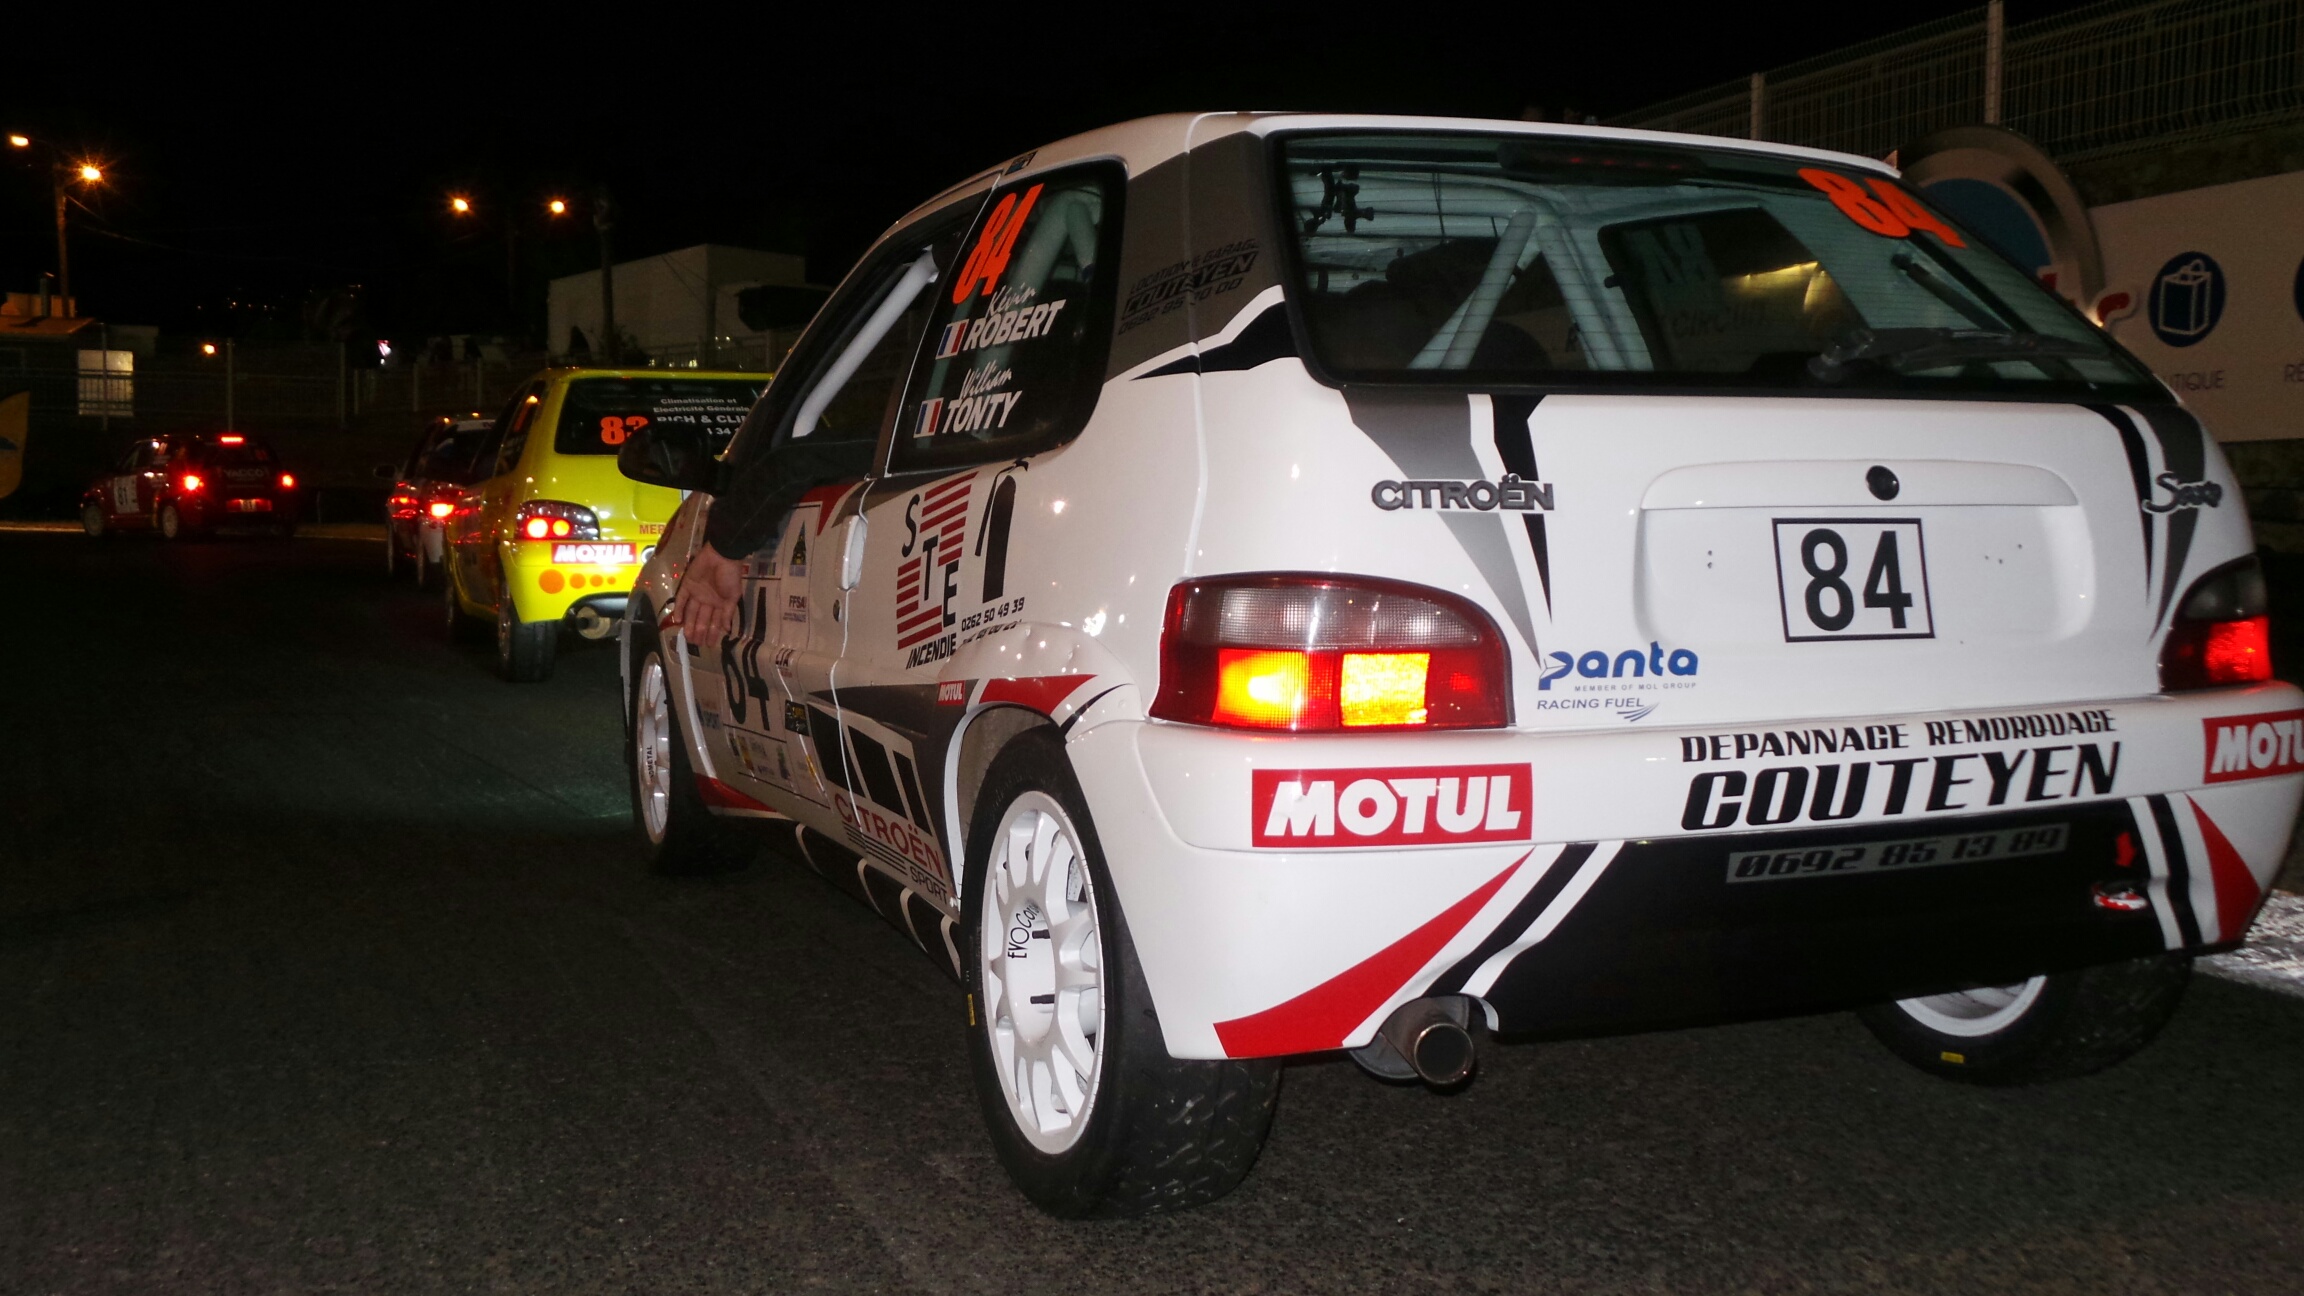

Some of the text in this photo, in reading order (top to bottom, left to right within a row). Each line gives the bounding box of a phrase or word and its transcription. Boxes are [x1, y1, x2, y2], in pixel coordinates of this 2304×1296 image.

[1799, 168, 1967, 248] 84
[952, 182, 1044, 305] 84
[963, 299, 1067, 352] ROBERT
[701, 414, 713, 424] &
[941, 390, 1023, 434] TONTY
[1371, 472, 1555, 511] CITROËN
[554, 543, 635, 564] MOTUL
[1799, 527, 1912, 632] 84
[961, 596, 1025, 632] 0262 50 49 39
[905, 632, 957, 671] INCENDIE
[938, 682, 963, 703] MOTUL
[1537, 696, 1645, 710] RACING FUEL
[1574, 684, 1618, 692] MEMBER
[1663, 682, 1698, 690] GROUP
[1681, 708, 2118, 763] DEPANNAGE REMORQUAGE
[1263, 775, 1522, 837] MOTUL
[1681, 741, 2123, 832] COUTEYEN
[834, 793, 944, 880] CITROËN
[1734, 825, 2062, 878] 0692 85 13 89
[909, 865, 948, 905] SPORT
